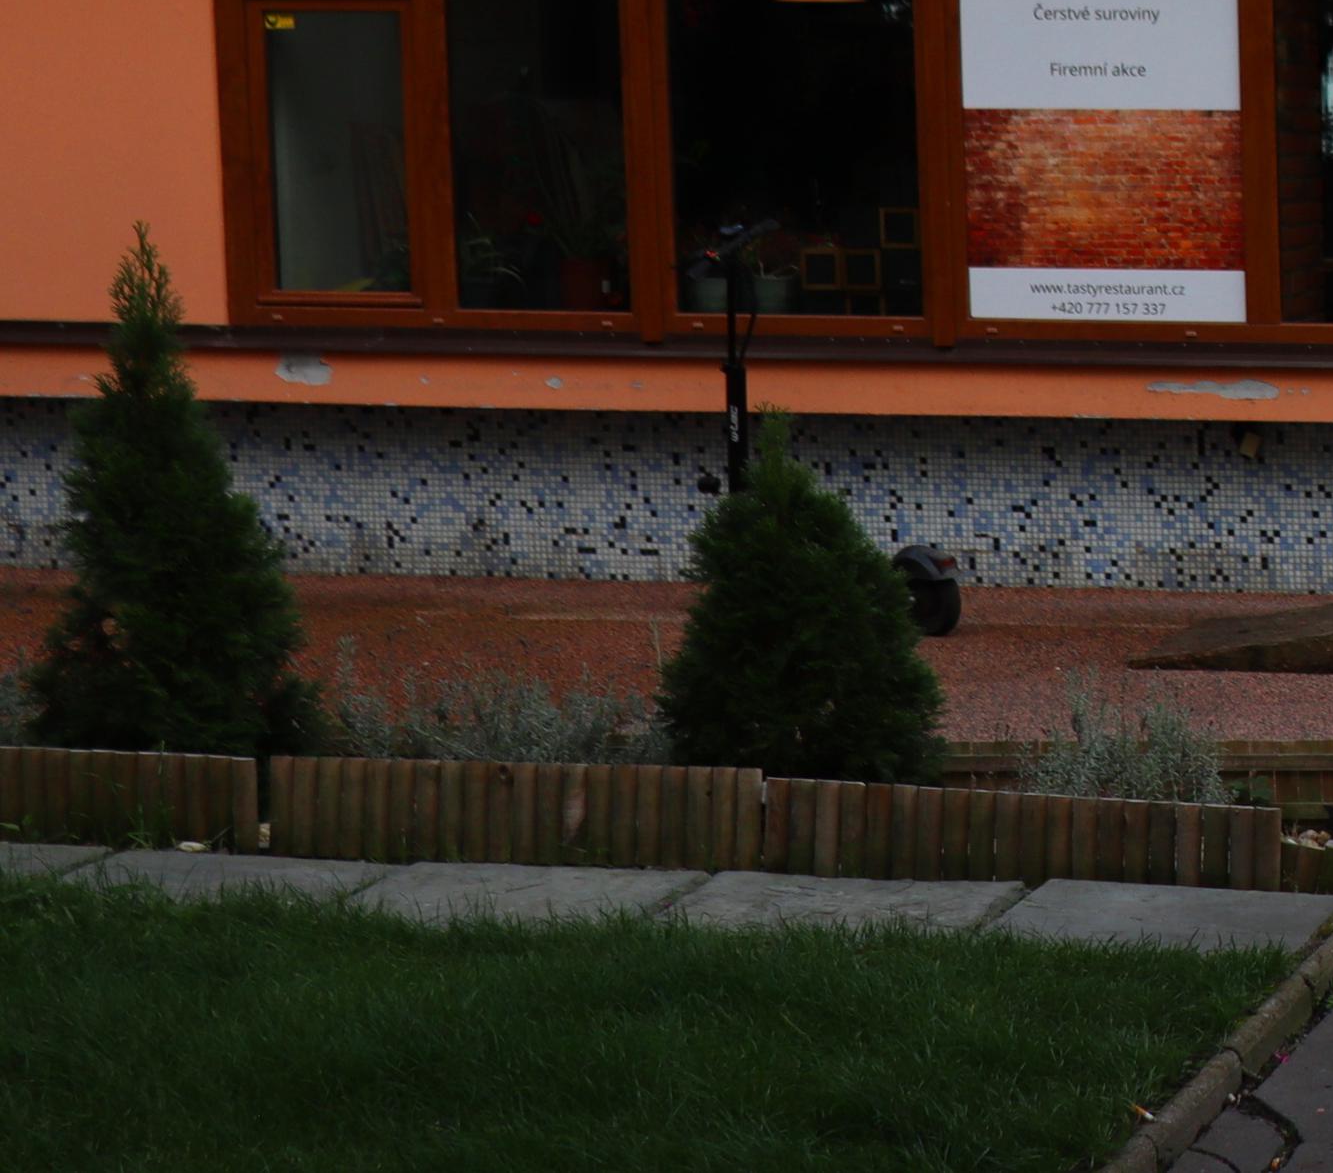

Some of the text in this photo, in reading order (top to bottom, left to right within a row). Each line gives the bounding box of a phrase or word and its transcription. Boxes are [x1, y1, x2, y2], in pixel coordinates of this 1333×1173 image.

[1033, 3, 1160, 24] Čerstvé suroviny
[1050, 63, 1146, 77] Firemní akce
[1030, 283, 1184, 297] www.tastyrestaurant.cz
[1051, 302, 1166, 315] +420 777 157 337
